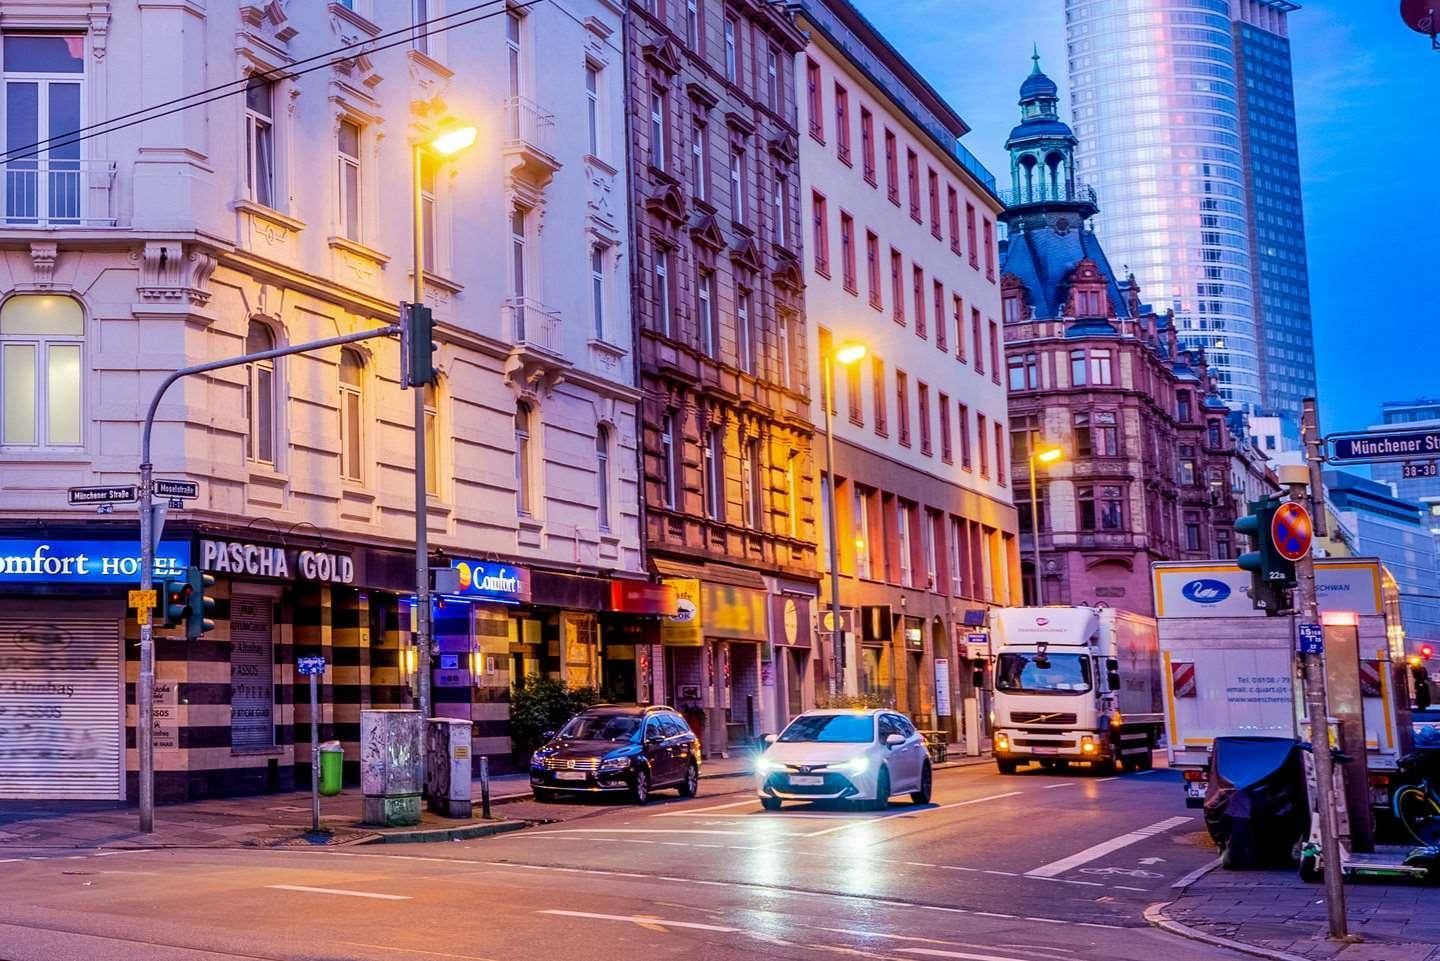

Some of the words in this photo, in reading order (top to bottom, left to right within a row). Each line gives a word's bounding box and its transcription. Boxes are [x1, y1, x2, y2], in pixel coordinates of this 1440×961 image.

[1351, 438, 1422, 455] Münchener
[1425, 434, 1440, 450] St
[74, 490, 107, 500] Münchener
[109, 489, 129, 499] Straße
[102, 557, 182, 575] HOEL
[201, 541, 289, 578] PASCHA
[299, 551, 354, 583] GOLD
[473, 567, 515, 592] Comfort
[1269, 571, 1286, 580] 22a
